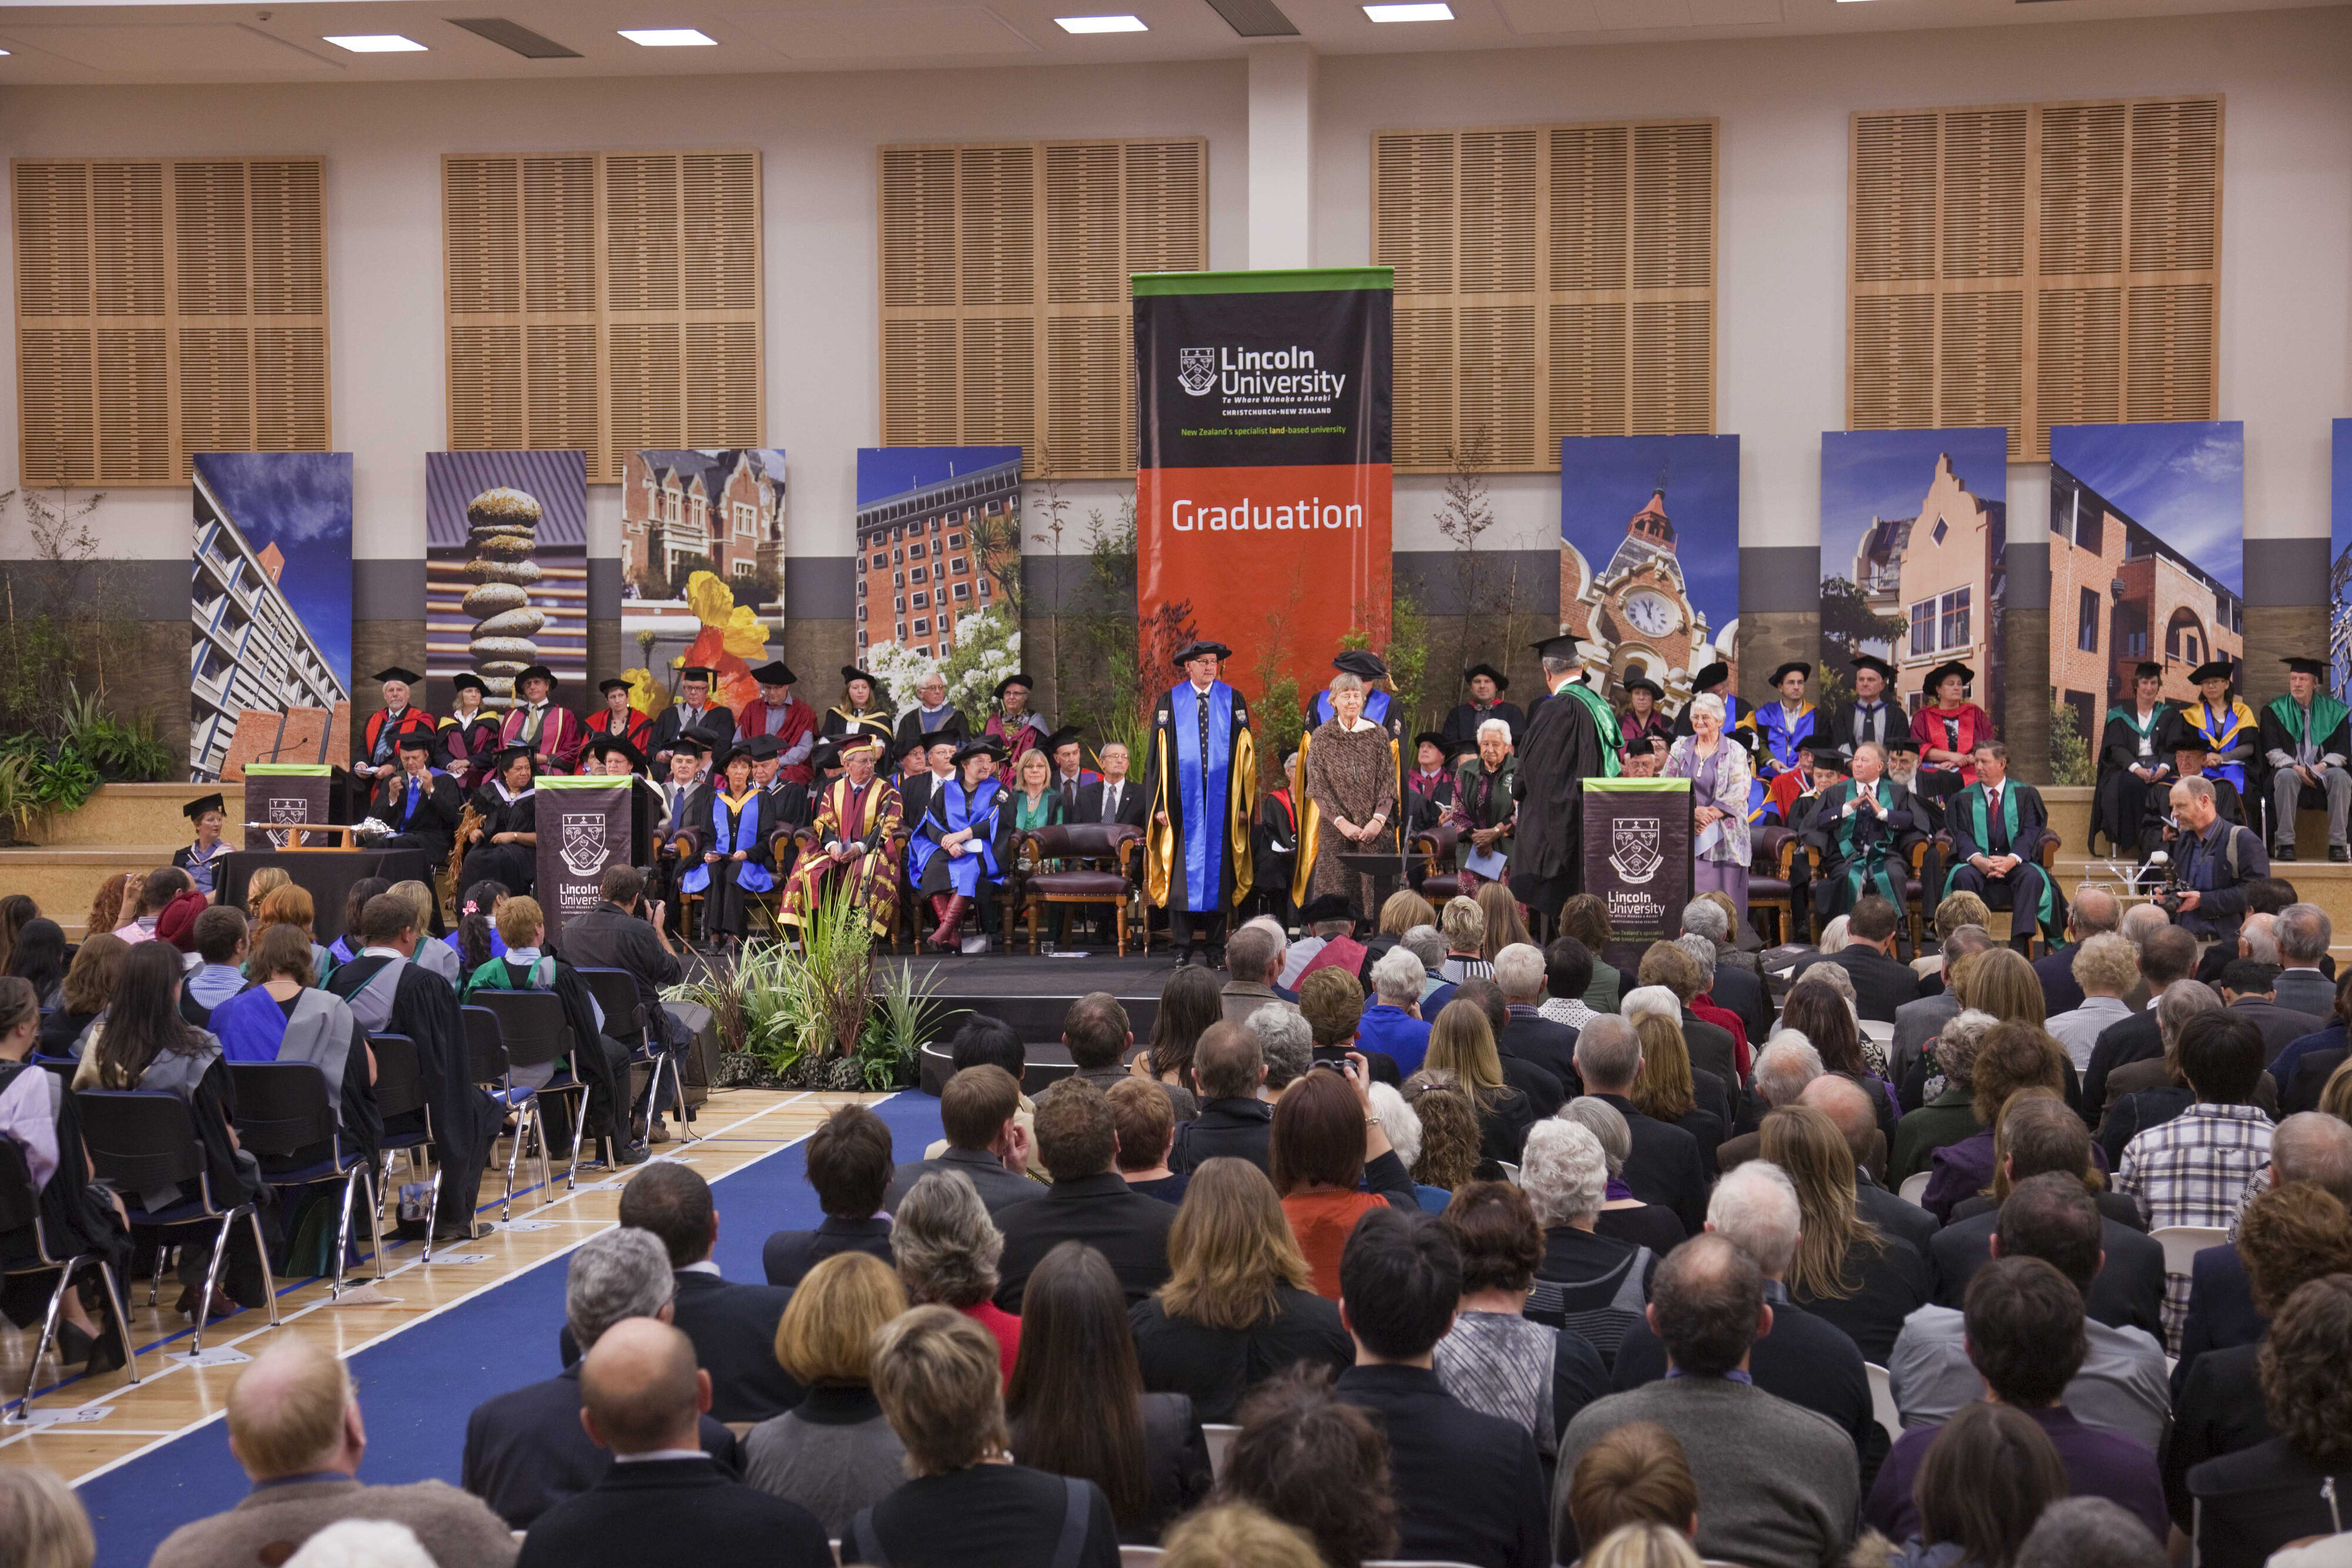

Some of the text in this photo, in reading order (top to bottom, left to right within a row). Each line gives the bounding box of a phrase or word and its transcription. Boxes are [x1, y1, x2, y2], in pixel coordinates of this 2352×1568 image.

[1222, 345, 1315, 370] Lincoln
[1222, 369, 1346, 398] University
[1199, 427, 1233, 436] Zealand's
[1235, 426, 1267, 436] specialist
[1310, 425, 1346, 434] university
[1172, 497, 1362, 531] Graduation
[560, 883, 598, 894] Lincoln
[560, 894, 600, 905] Universi
[1608, 891, 1651, 903] Lincoln
[1609, 902, 1665, 916] University
